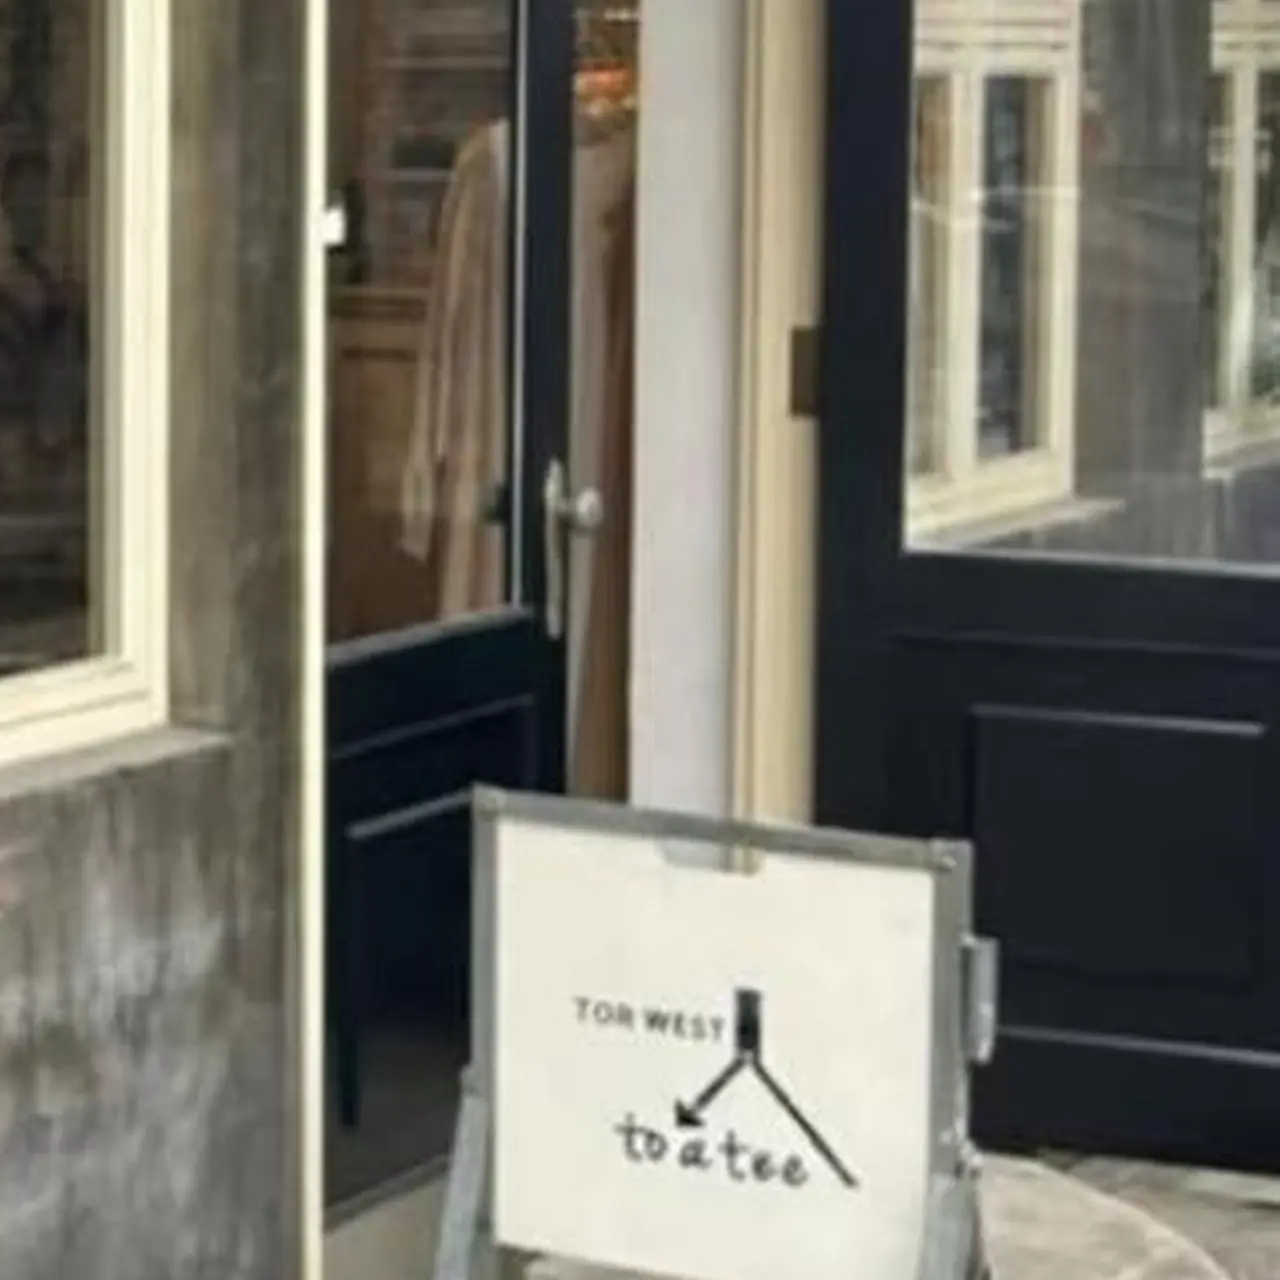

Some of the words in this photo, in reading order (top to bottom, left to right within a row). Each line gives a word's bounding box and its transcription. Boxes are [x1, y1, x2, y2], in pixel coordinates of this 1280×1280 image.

[573, 996, 635, 1031] TOR
[642, 1009, 727, 1042] WEST
[614, 1112, 671, 1164] to
[677, 1138, 713, 1170] a
[719, 1129, 812, 1187] tee
